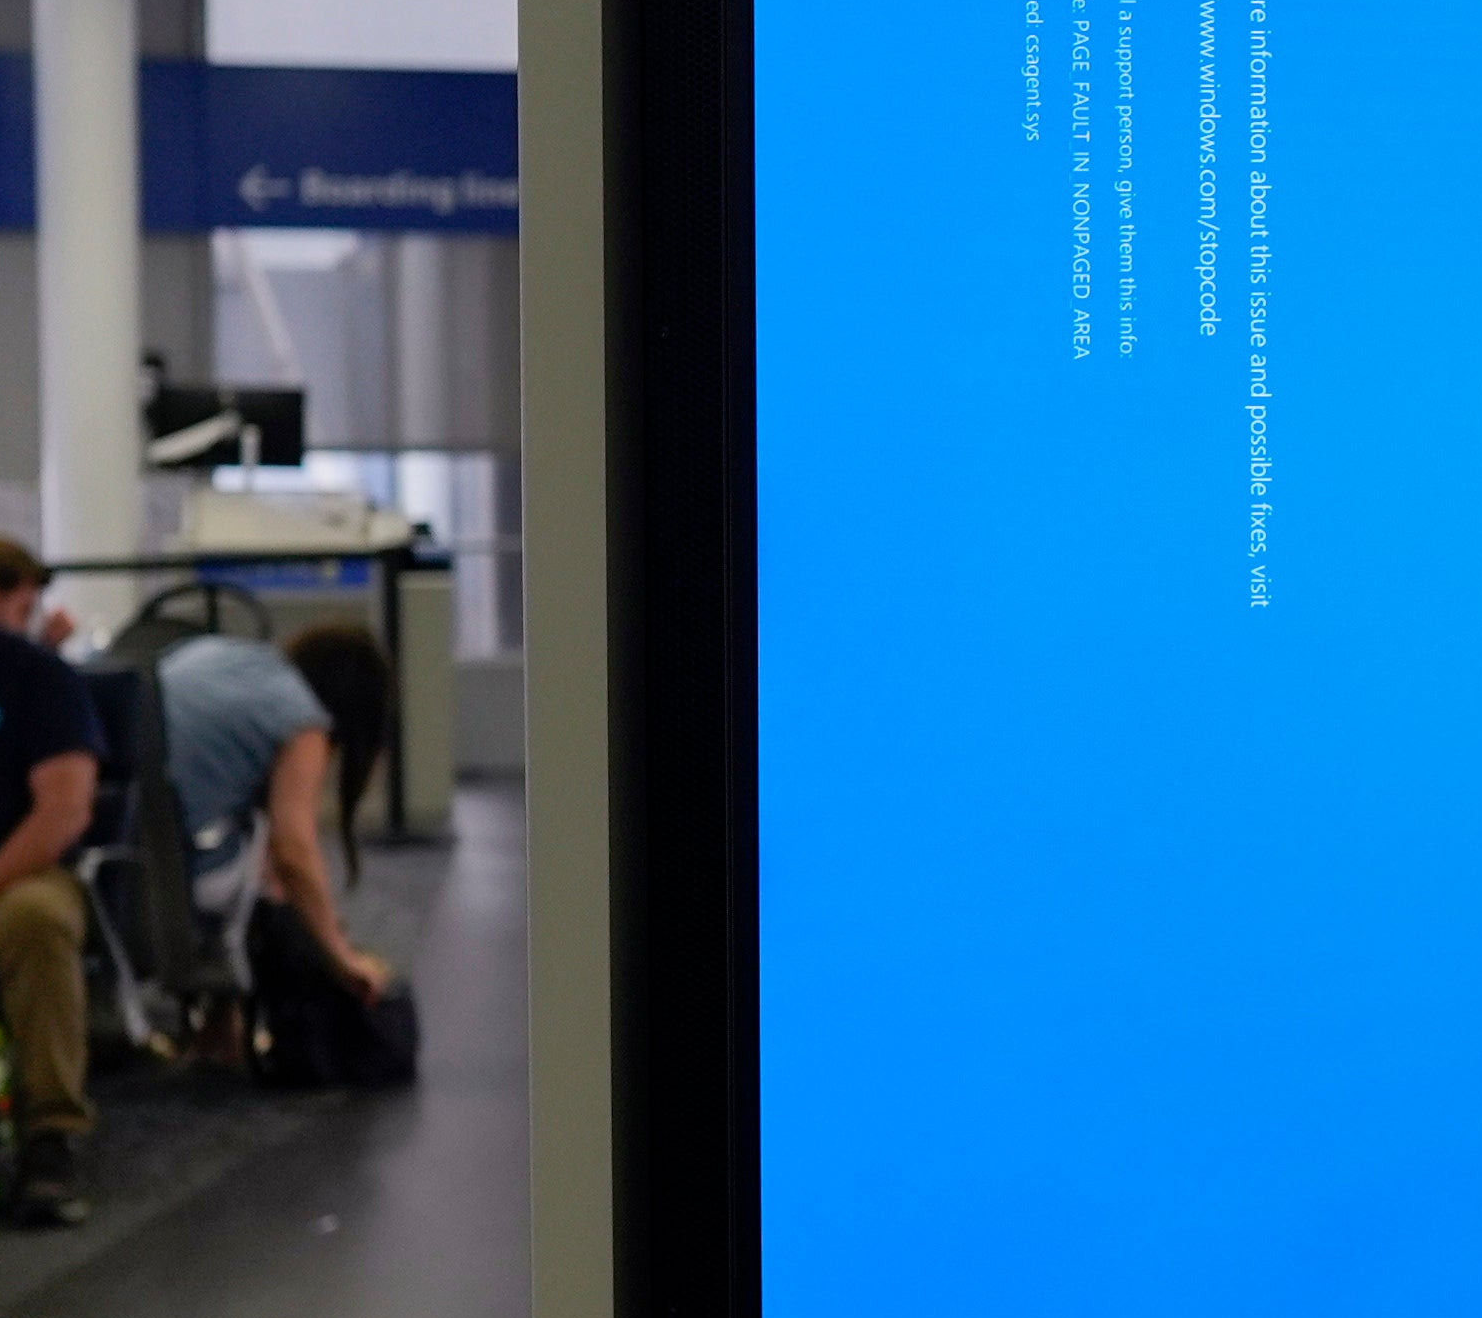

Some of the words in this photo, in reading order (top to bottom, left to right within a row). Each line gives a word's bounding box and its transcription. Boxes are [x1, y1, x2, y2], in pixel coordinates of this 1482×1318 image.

[1119, 10, 1132, 21] a
[1021, 34, 1042, 141] csagent.sys
[1116, 26, 1135, 99] support
[1249, 30, 1273, 163] information
[1116, 105, 1133, 173] person,
[1069, 20, 1091, 360] PAGE_FAULT_IN_NONPAGED_AREA
[1114, 180, 1136, 219] give
[1249, 170, 1273, 238] about
[1119, 224, 1137, 272] them
[1250, 245, 1273, 284] this
[1119, 277, 1137, 311] this
[1249, 291, 1271, 348] issue
[1119, 316, 1138, 360] info:
[1250, 353, 1273, 398] and
[1244, 405, 1273, 496] possible
[1247, 502, 1273, 558] fixes,
[1250, 565, 1272, 608] visit
